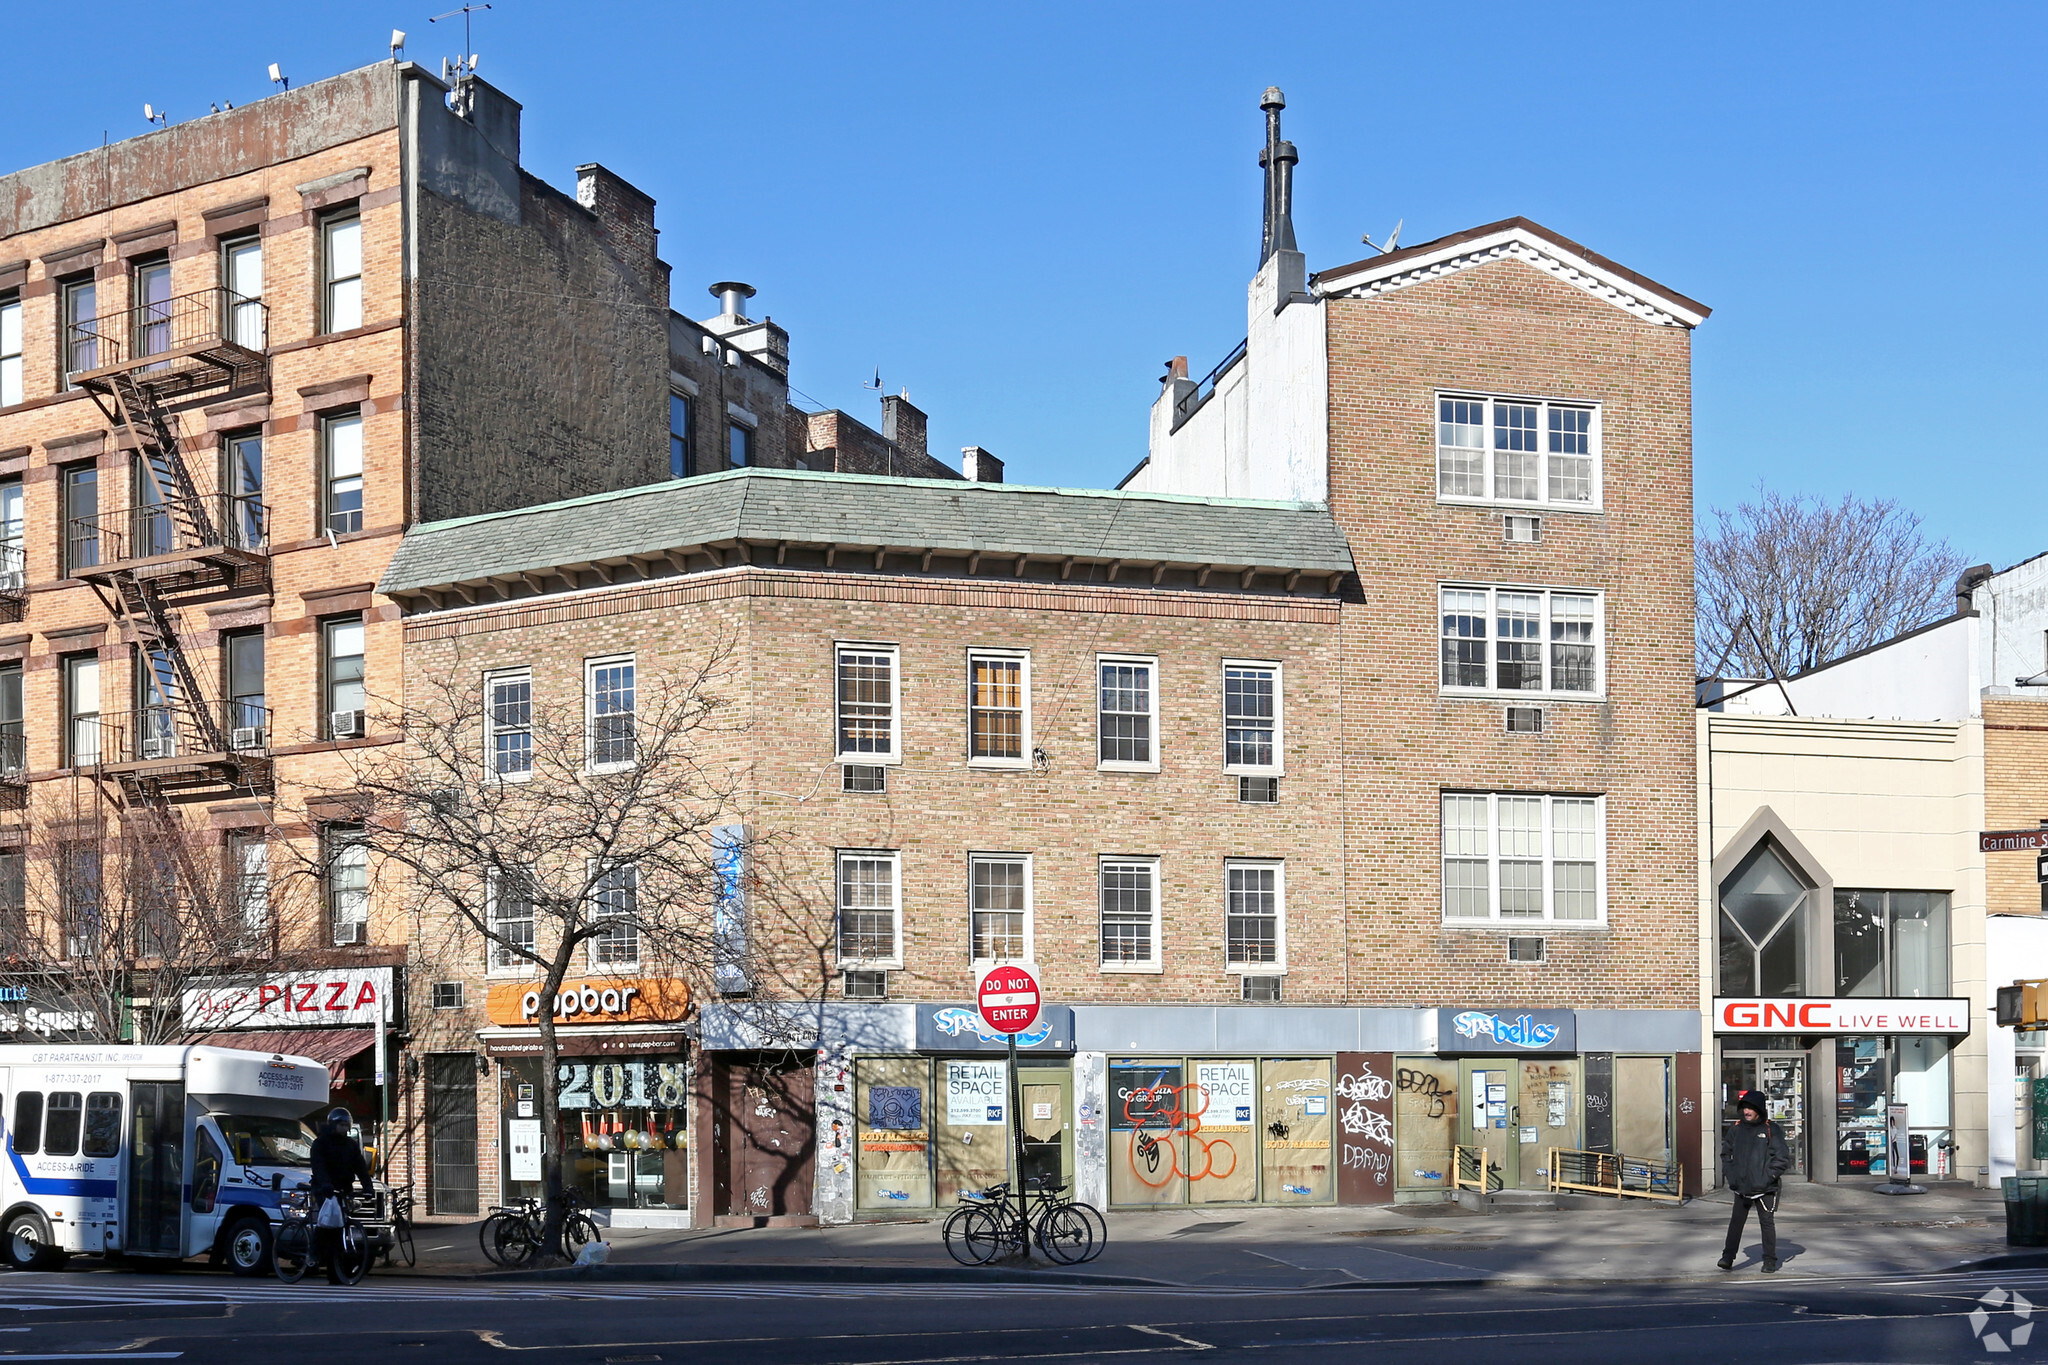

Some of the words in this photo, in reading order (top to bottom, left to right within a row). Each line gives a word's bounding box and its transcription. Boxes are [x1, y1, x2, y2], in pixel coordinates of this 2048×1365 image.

[1983, 834, 2036, 851] Carmine
[986, 980, 1001, 991] DO
[1008, 978, 1029, 989] NOT
[259, 981, 376, 1013] PIZZA
[992, 1009, 1028, 1021] ENTER
[1723, 1003, 1831, 1027] GNC
[1839, 1015, 1888, 1027] LIVE
[1898, 1015, 1959, 1028] WELL
[24, 1007, 94, 1037] Square
[936, 1009, 979, 1036] Spa
[1457, 1013, 1495, 1039] Spa
[1490, 1014, 1557, 1044] belles
[490, 1044, 522, 1052] handcrafted
[32, 1053, 47, 1062] CBT
[45, 1074, 102, 1083] 1-877-337-2017
[258, 1071, 304, 1084] ACCESS-A-RIDE
[950, 1066, 1002, 1079] RETAIL
[1200, 1068, 1249, 1081] RETAIL
[258, 1079, 304, 1091] 1-877-337-2017
[559, 1064, 685, 1108] 2018
[950, 1081, 1002, 1094] SPACE
[1200, 1082, 1249, 1096] SPACE
[950, 1096, 1001, 1105] AVAILABLE
[987, 1109, 1002, 1118] RKF
[1236, 1109, 1250, 1118] RKF
[859, 1132, 886, 1142] BODY
[1265, 1140, 1289, 1149] BODY
[37, 1162, 95, 1173] ACCESS-A-RIDE
